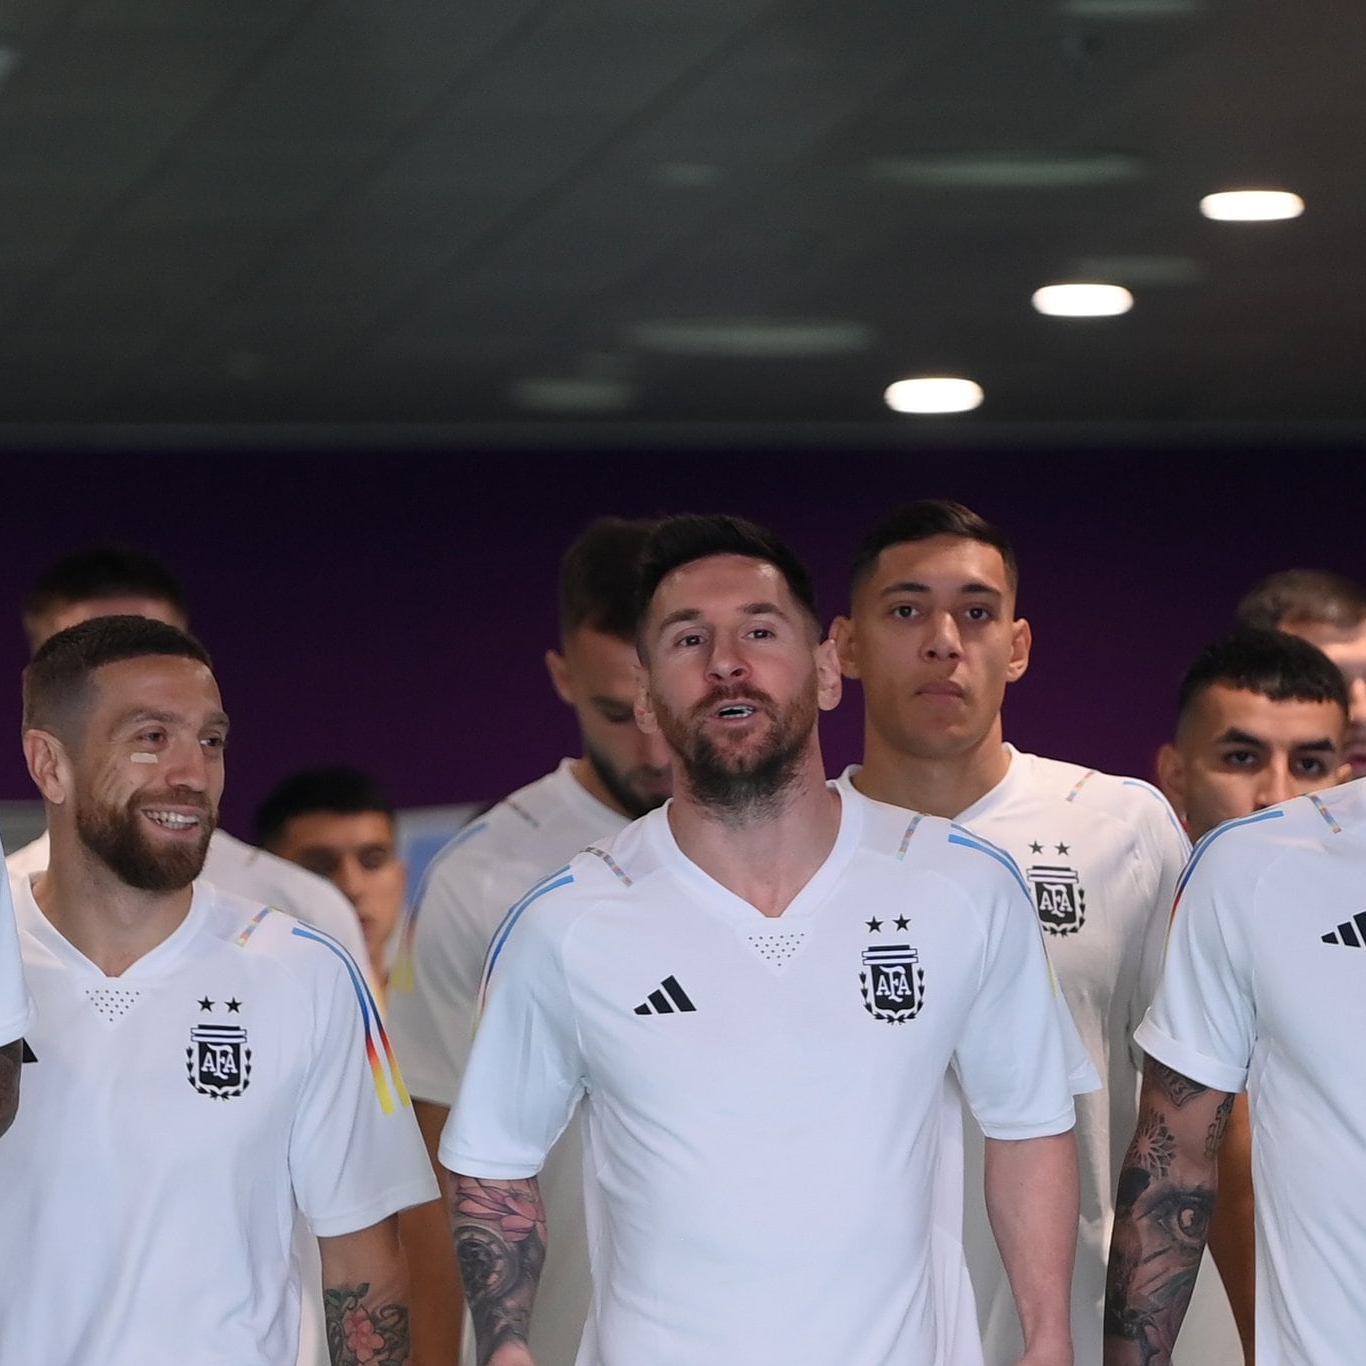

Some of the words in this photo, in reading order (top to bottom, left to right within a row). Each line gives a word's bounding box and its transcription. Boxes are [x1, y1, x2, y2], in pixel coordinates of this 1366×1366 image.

[1039, 884, 1074, 917] AFA
[876, 966, 912, 1003] AFA
[202, 1043, 238, 1079] AFA
